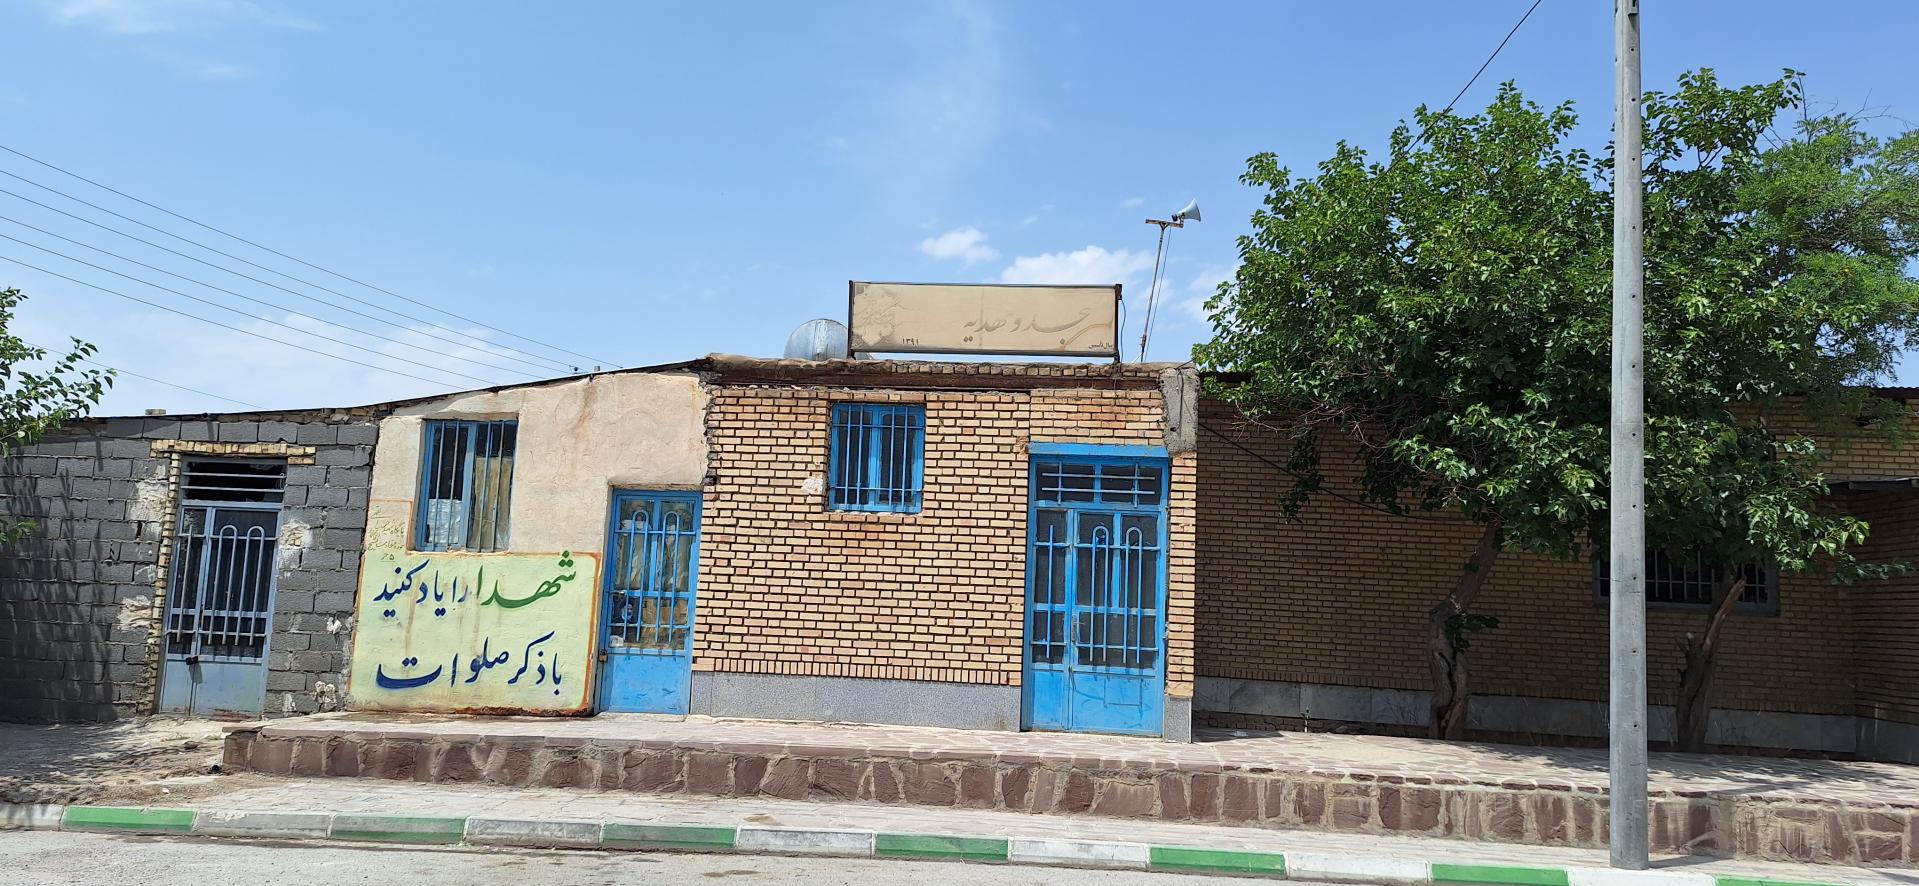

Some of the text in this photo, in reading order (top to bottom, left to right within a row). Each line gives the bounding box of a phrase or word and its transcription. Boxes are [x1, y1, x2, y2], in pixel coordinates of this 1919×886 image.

[902, 337, 919, 346] ۱۳۹۱
[373, 550, 577, 618] شهدا را یاد کنید
[375, 630, 562, 696] با ذکر صلوات
